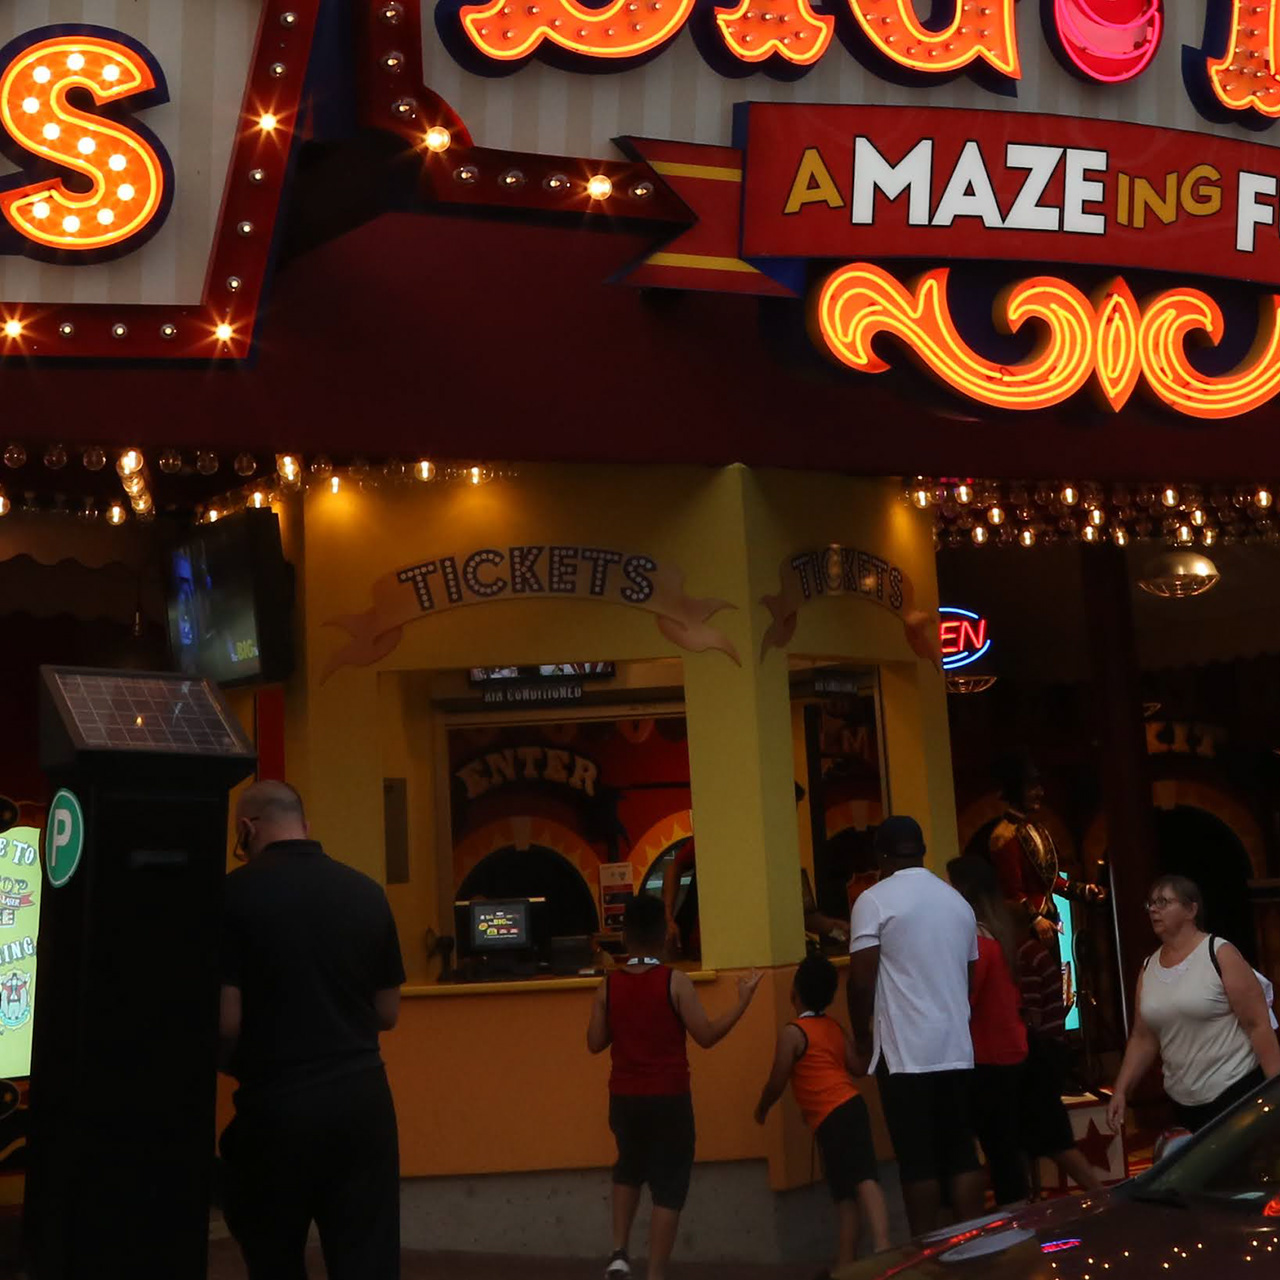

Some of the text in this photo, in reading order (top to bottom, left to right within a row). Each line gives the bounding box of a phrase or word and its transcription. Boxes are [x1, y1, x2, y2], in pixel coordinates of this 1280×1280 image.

[397, 545, 659, 611] TICKETS
[791, 545, 904, 611] TICKETS
[939, 619, 987, 654] EN
[507, 685, 582, 701] CONDITIONED
[455, 745, 601, 798] ENTER
[12, 839, 35, 865] TO
[51, 809, 71, 866] P
